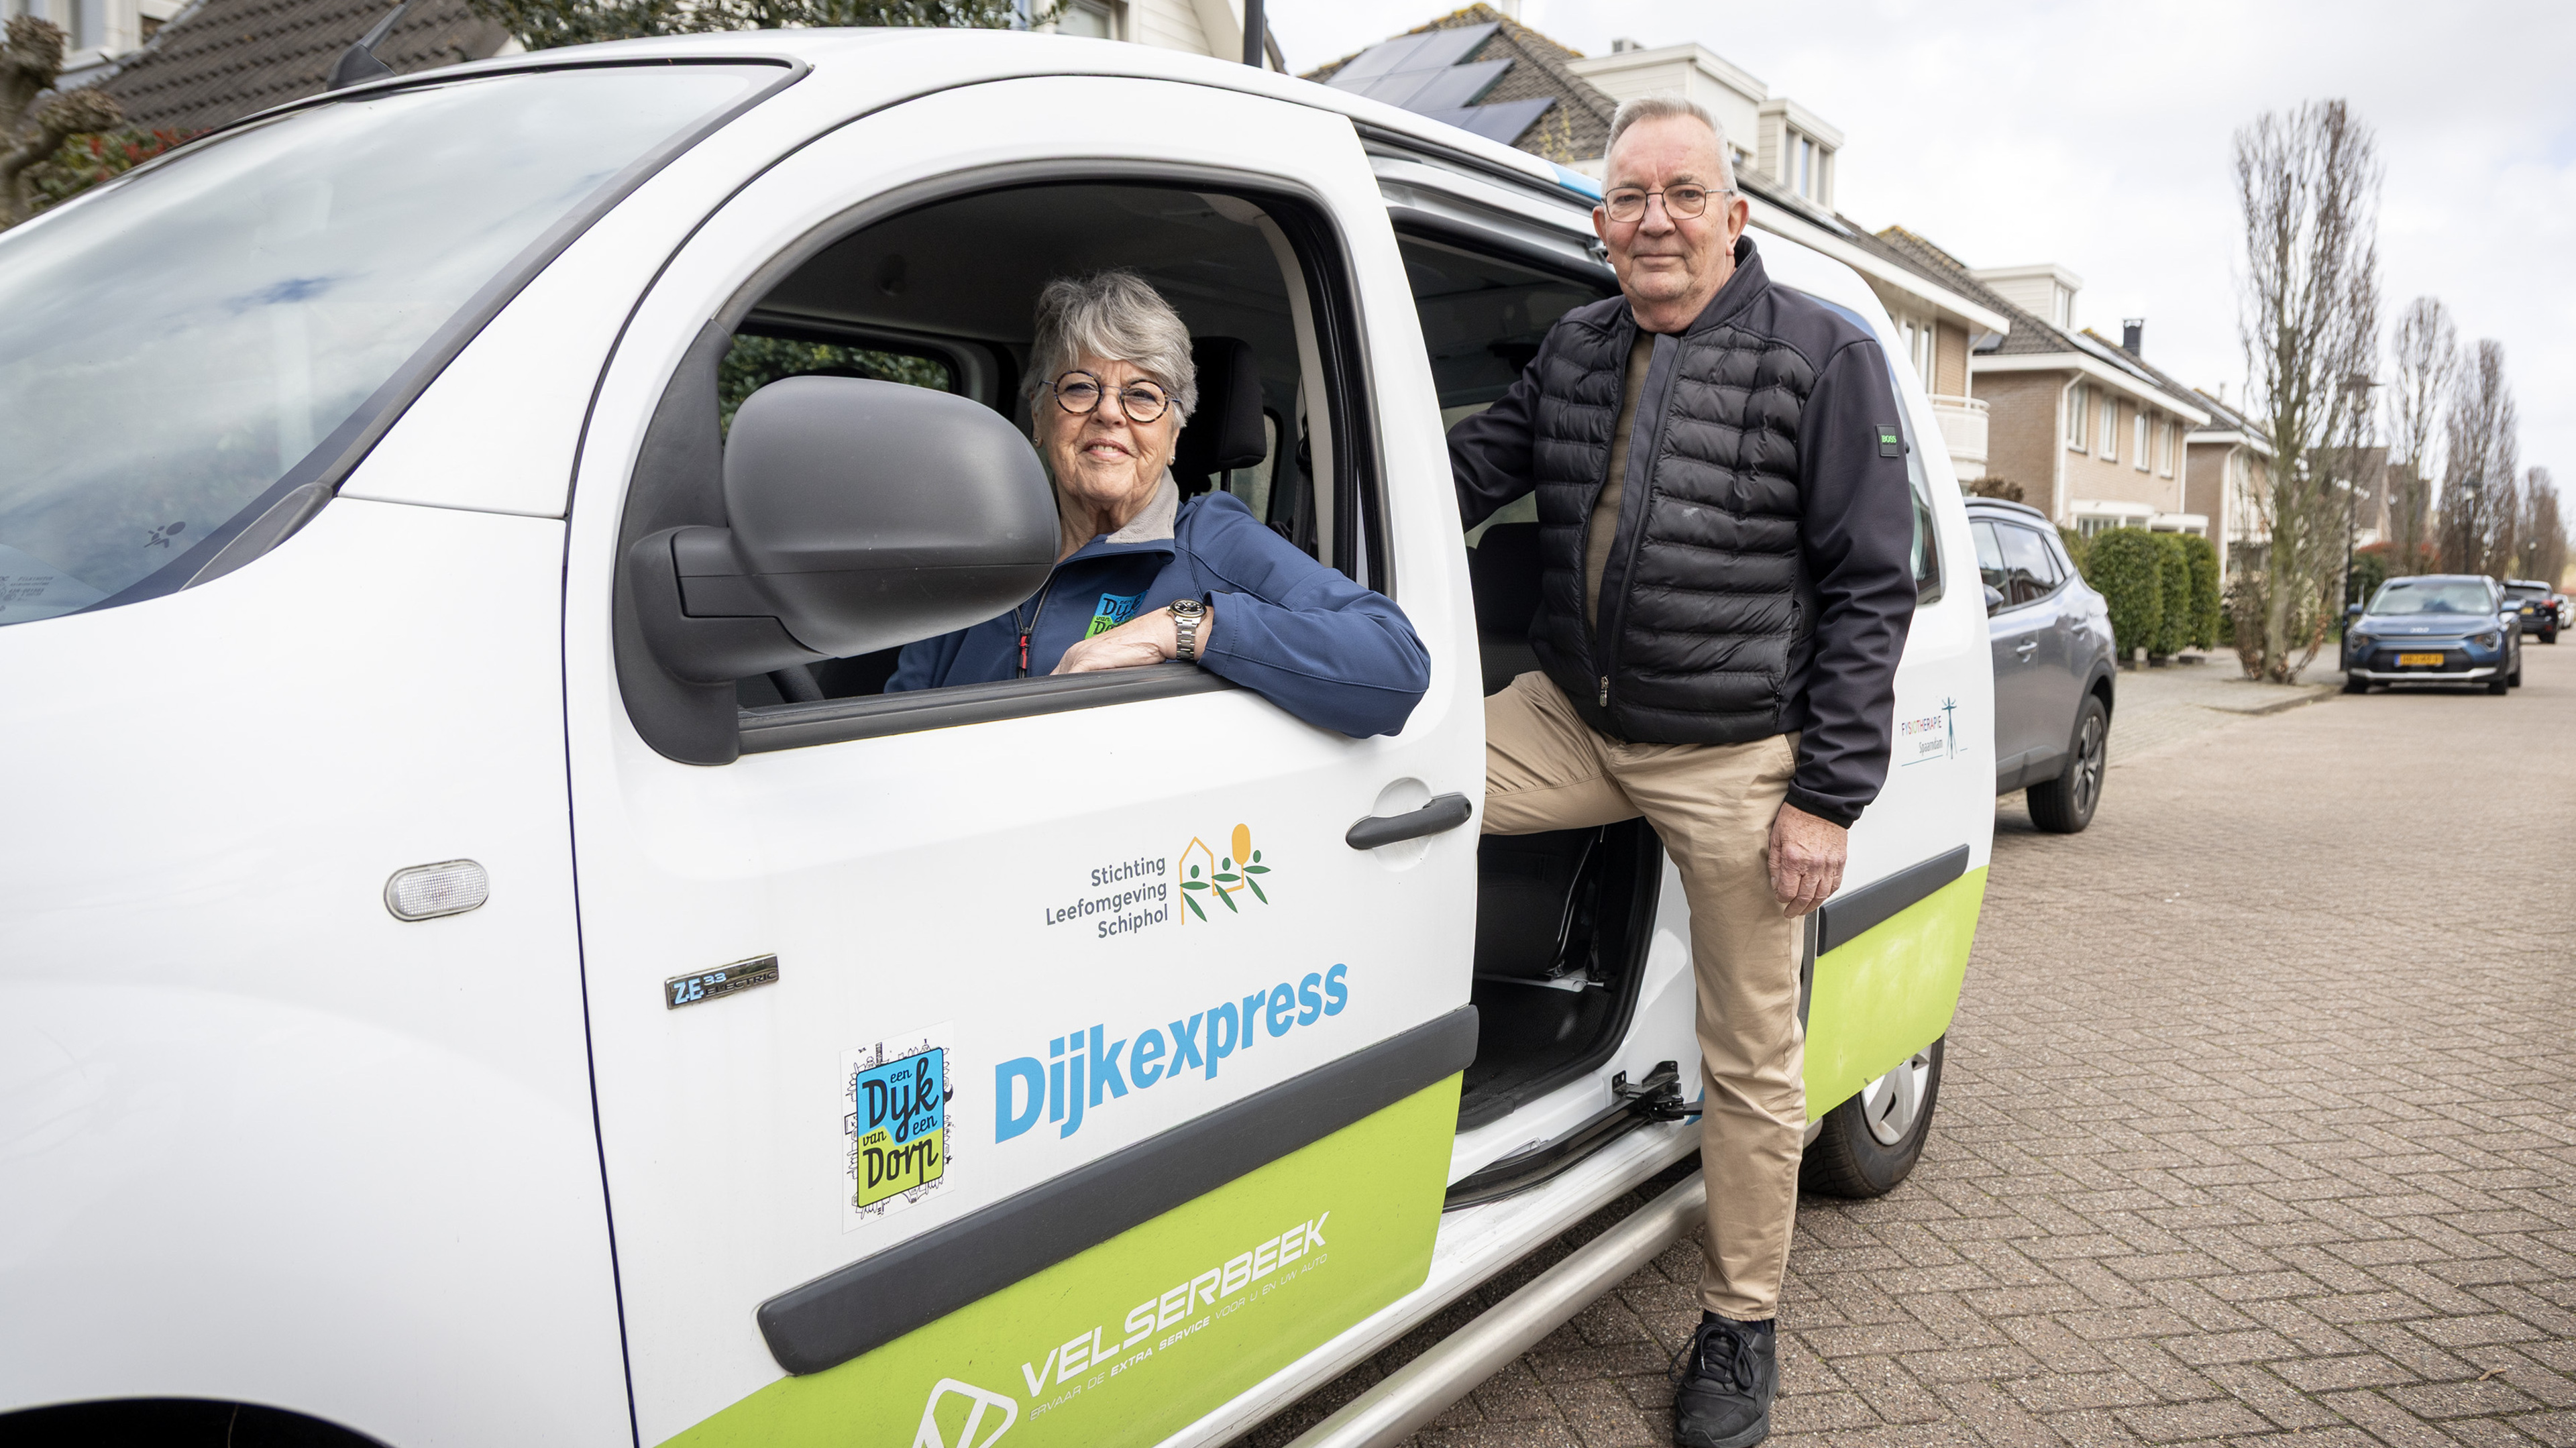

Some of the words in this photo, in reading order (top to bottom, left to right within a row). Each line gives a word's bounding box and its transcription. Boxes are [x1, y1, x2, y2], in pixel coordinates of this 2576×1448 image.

[1901, 716, 1942, 736] FYSIOTHERAPIE
[1919, 736, 1943, 757] Spaarndam
[1091, 856, 1166, 887] Stichting
[1046, 882, 1167, 926] Leefomgeving
[1098, 903, 1169, 939] Schiphol
[704, 972, 727, 985] 33
[706, 971, 777, 997] ELECTRIC
[996, 963, 1348, 1145] Dijkexpress
[890, 1069, 912, 1084] een
[863, 1131, 887, 1147] van
[913, 1115, 938, 1135] een
[863, 1138, 939, 1190] Dorp
[1021, 1211, 1330, 1398] VELSERBEEK
[1030, 1385, 1081, 1421] ERVAAR
[1087, 1372, 1106, 1390] DE
[1110, 1347, 1153, 1378] EXTRA
[1159, 1316, 1211, 1351] SERVICE
[1215, 1297, 1246, 1320] VOOR
[1250, 1290, 1258, 1302] U
[1262, 1280, 1277, 1296] EN
[1280, 1270, 1297, 1286] UW
[1301, 1254, 1328, 1274] AUTO
